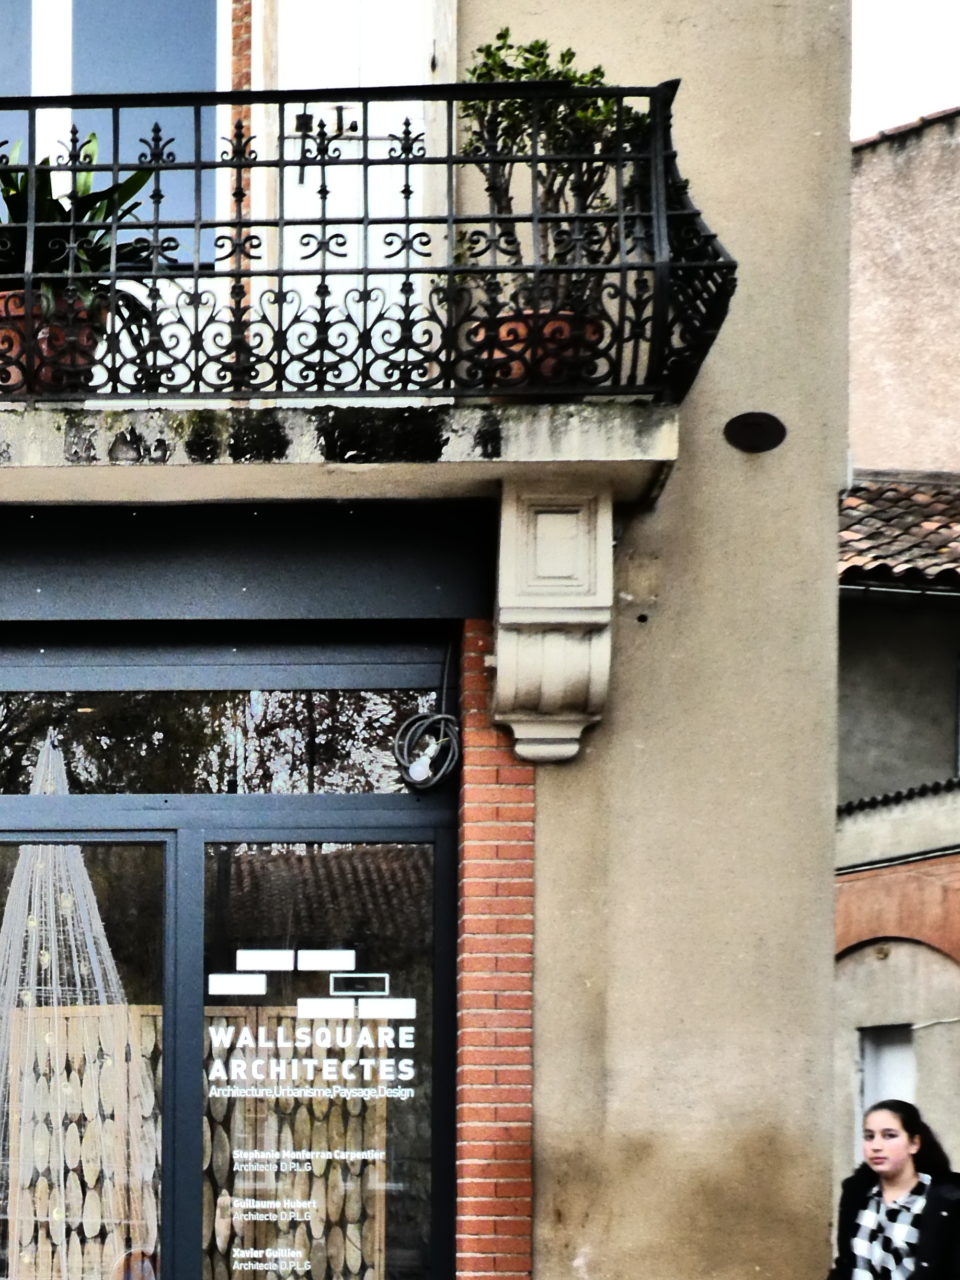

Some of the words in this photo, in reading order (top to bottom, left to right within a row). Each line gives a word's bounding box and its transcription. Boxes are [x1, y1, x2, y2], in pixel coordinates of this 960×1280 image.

[208, 1026, 416, 1048] WALLSQUARE
[208, 1058, 416, 1080] ARCHITECTES
[281, 1150, 333, 1159] Monferran
[333, 1150, 386, 1161] Carpentier
[232, 1162, 278, 1172] Architecte
[233, 1198, 281, 1208] Guillaume
[283, 1199, 317, 1208] Hubert
[232, 1211, 278, 1221] Architecte
[232, 1247, 264, 1258] Xavier
[232, 1260, 278, 1271] Architecte
